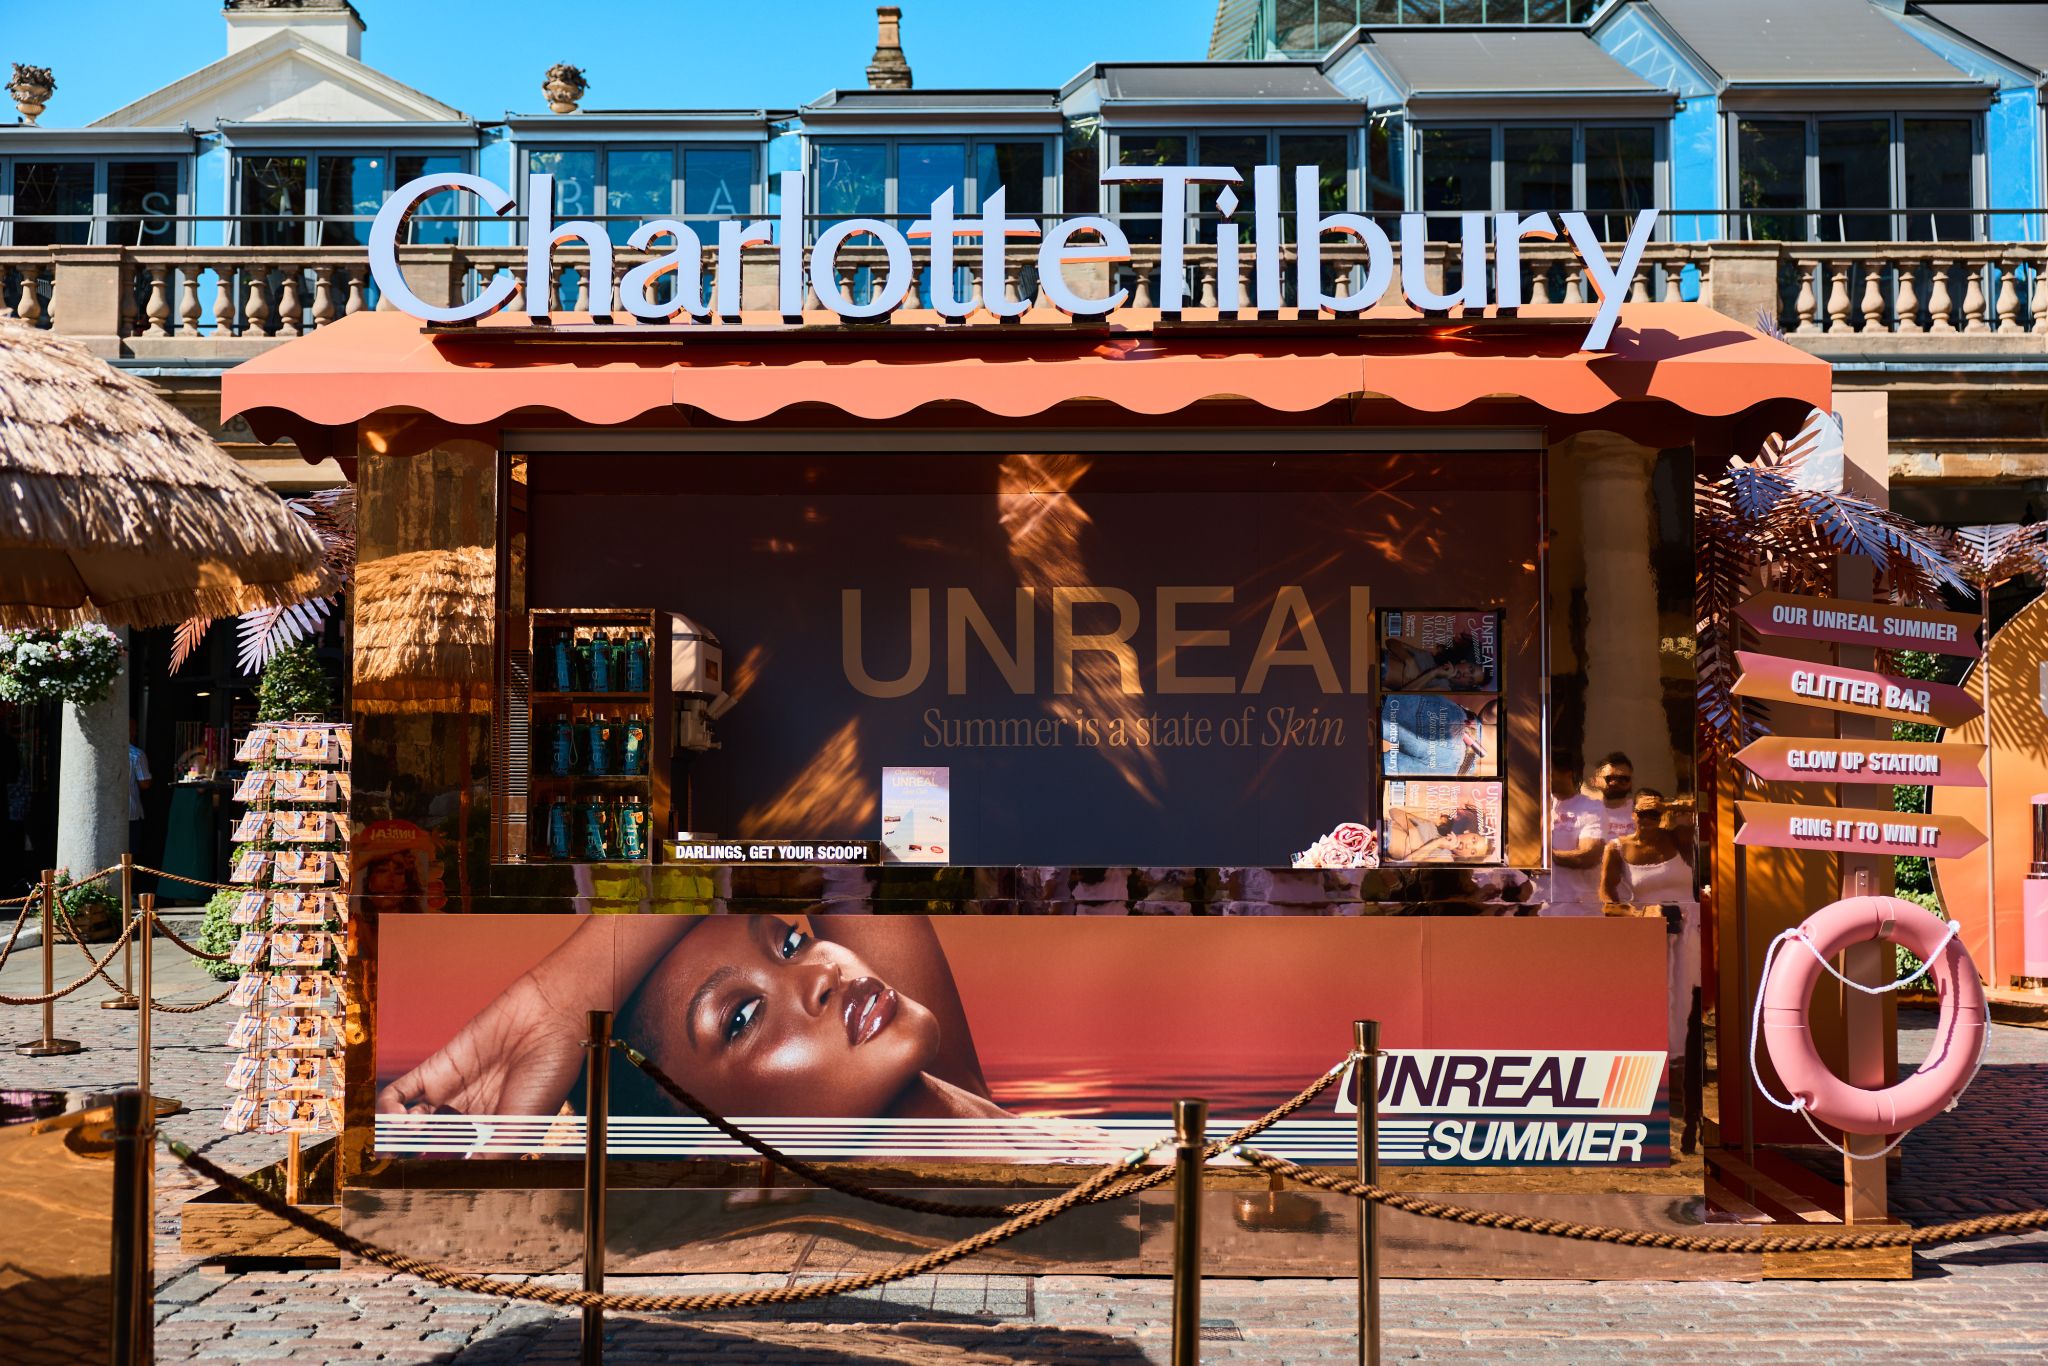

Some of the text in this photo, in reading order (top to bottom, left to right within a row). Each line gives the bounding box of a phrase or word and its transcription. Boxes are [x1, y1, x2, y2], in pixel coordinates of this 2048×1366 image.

[1772, 605, 1958, 642] OUR UNREAL SUMMER
[1791, 670, 1931, 714] GLITTER BAR
[923, 707, 1067, 748] Summer
[1074, 707, 1099, 747] is
[1109, 716, 1128, 747] a
[1135, 712, 1212, 747] state
[1219, 705, 1256, 747] of
[1260, 706, 1345, 747] Skin
[1788, 750, 1939, 773] GLOW UP STATION
[1789, 817, 1939, 845] RING IT TO WIN IT
[675, 845, 867, 861] DARLINGS, GET YOUR SCOOP!
[1346, 1055, 1600, 1108] UNREAL
[1427, 1120, 1648, 1162] SUMMER
